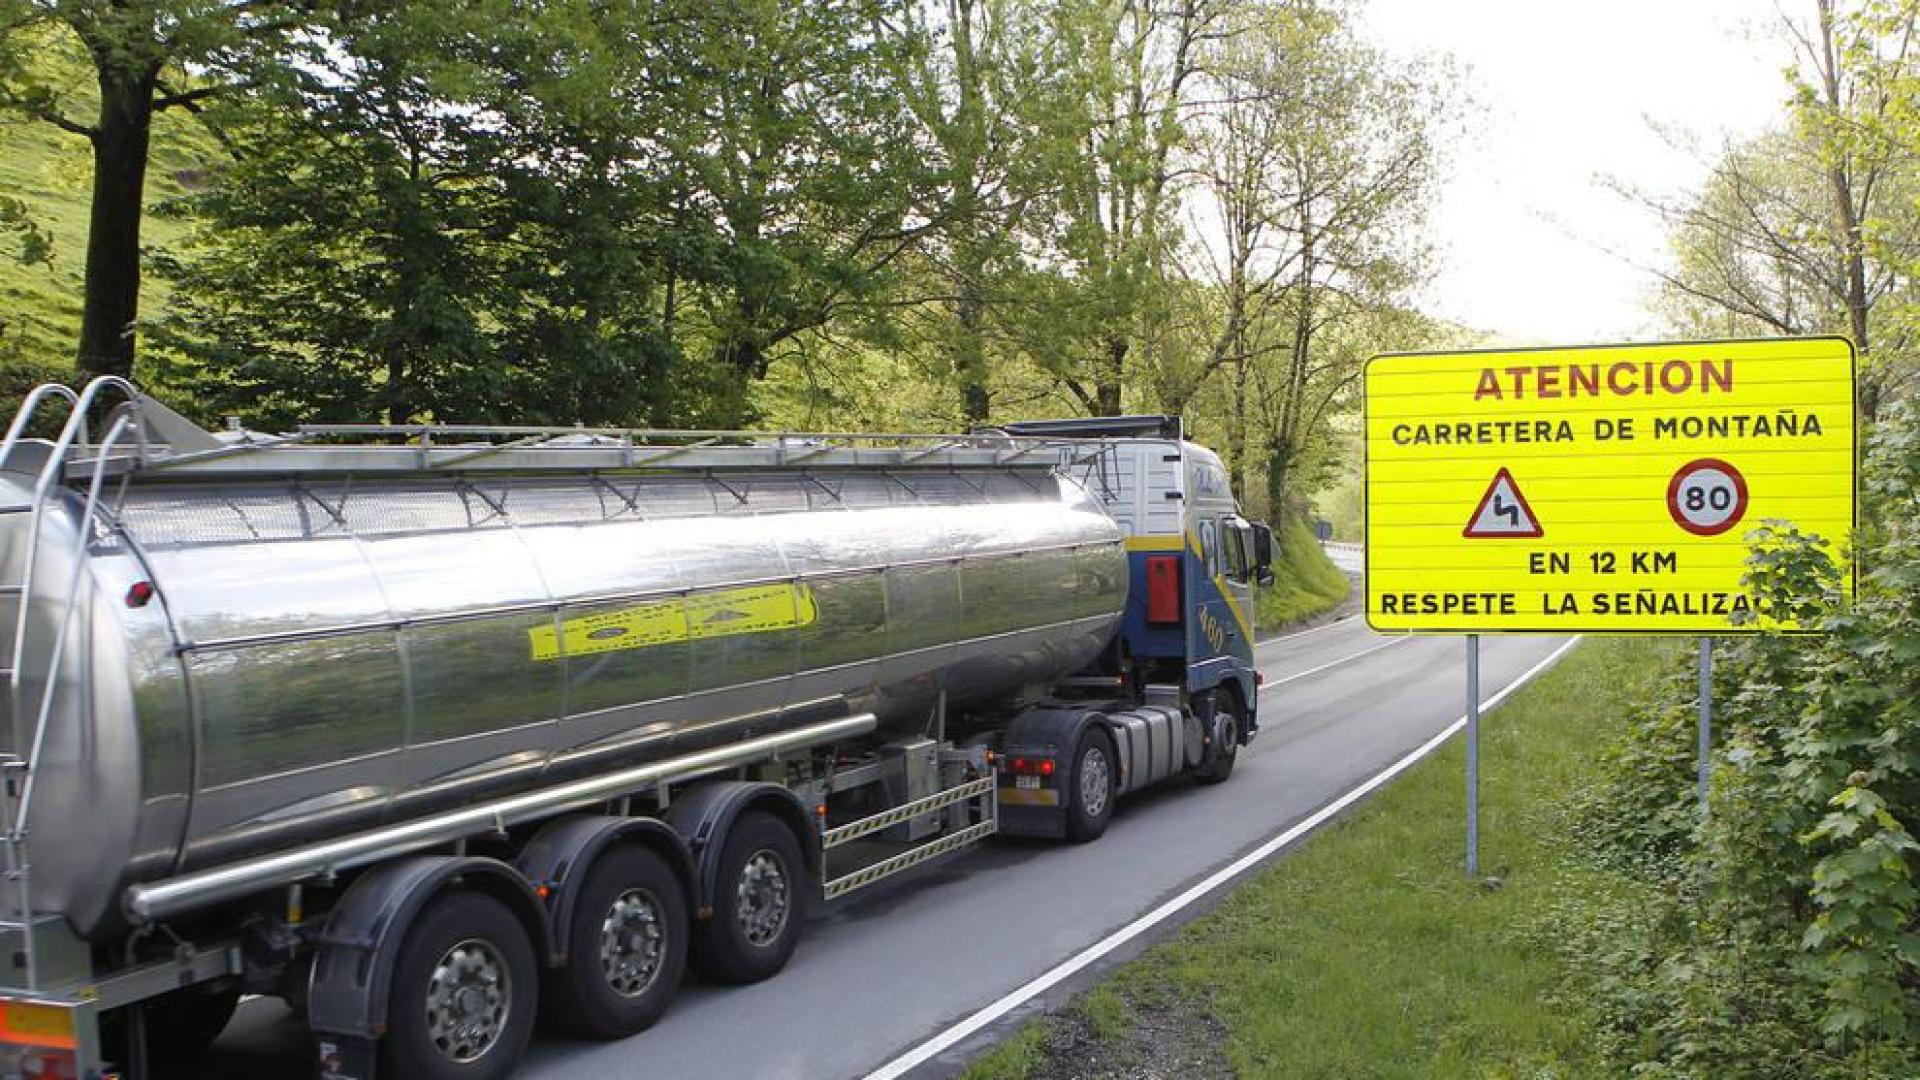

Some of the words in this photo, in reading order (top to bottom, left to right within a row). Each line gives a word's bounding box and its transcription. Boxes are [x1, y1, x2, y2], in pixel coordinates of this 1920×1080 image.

[1474, 358, 1734, 401] ATENCION
[1392, 420, 1574, 445] CARRETERA
[1595, 418, 1634, 441] DE
[1654, 410, 1823, 439] MONTAÑA
[1684, 485, 1732, 512] 80
[1529, 552, 1570, 575] EN
[1589, 552, 1616, 575] 12
[1632, 551, 1678, 575] KM
[1381, 592, 1517, 616] RESPETE
[1543, 592, 1580, 616] LA
